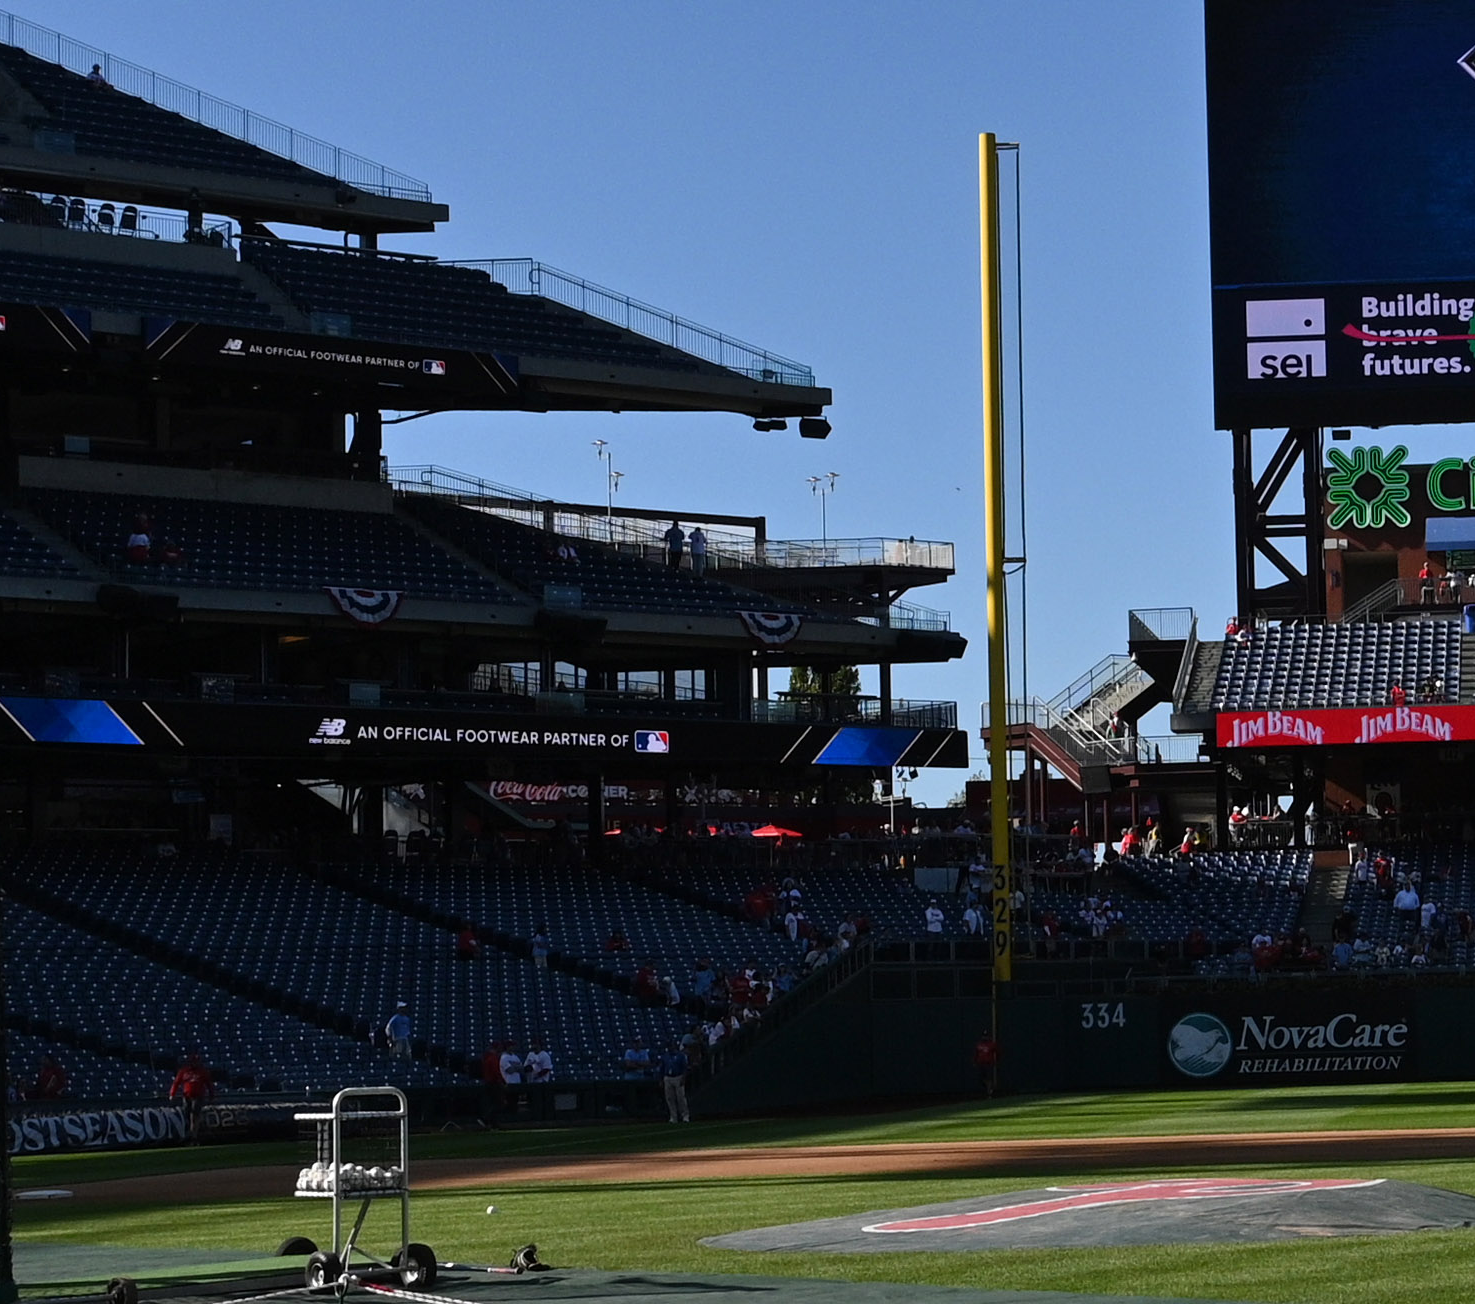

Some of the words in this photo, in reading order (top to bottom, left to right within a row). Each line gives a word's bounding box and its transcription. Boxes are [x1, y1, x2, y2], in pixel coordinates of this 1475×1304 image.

[1361, 293, 1475, 321] Building
[249, 344, 263, 354] AN
[265, 345, 308, 359] OFFICIAL
[310, 350, 363, 365] FOOTWEAR
[365, 355, 406, 369] PARTNER
[407, 360, 421, 370] OF
[1361, 353, 1471, 377] futures.
[357, 726, 378, 739] AN
[383, 726, 451, 742] OFFICIAL
[456, 728, 539, 745] FOOTWEAR
[543, 732, 606, 747] PARTNER
[610, 734, 629, 747] OF
[1227, 717, 1265, 747] JIM
[1267, 711, 1325, 745] BEAM
[1354, 714, 1392, 744] JIM
[1395, 706, 1455, 742] BEAM
[1080, 1002, 1126, 1029] 334
[1236, 1014, 1408, 1050] NovaCare
[1238, 1056, 1402, 1073] REHABILITATION
